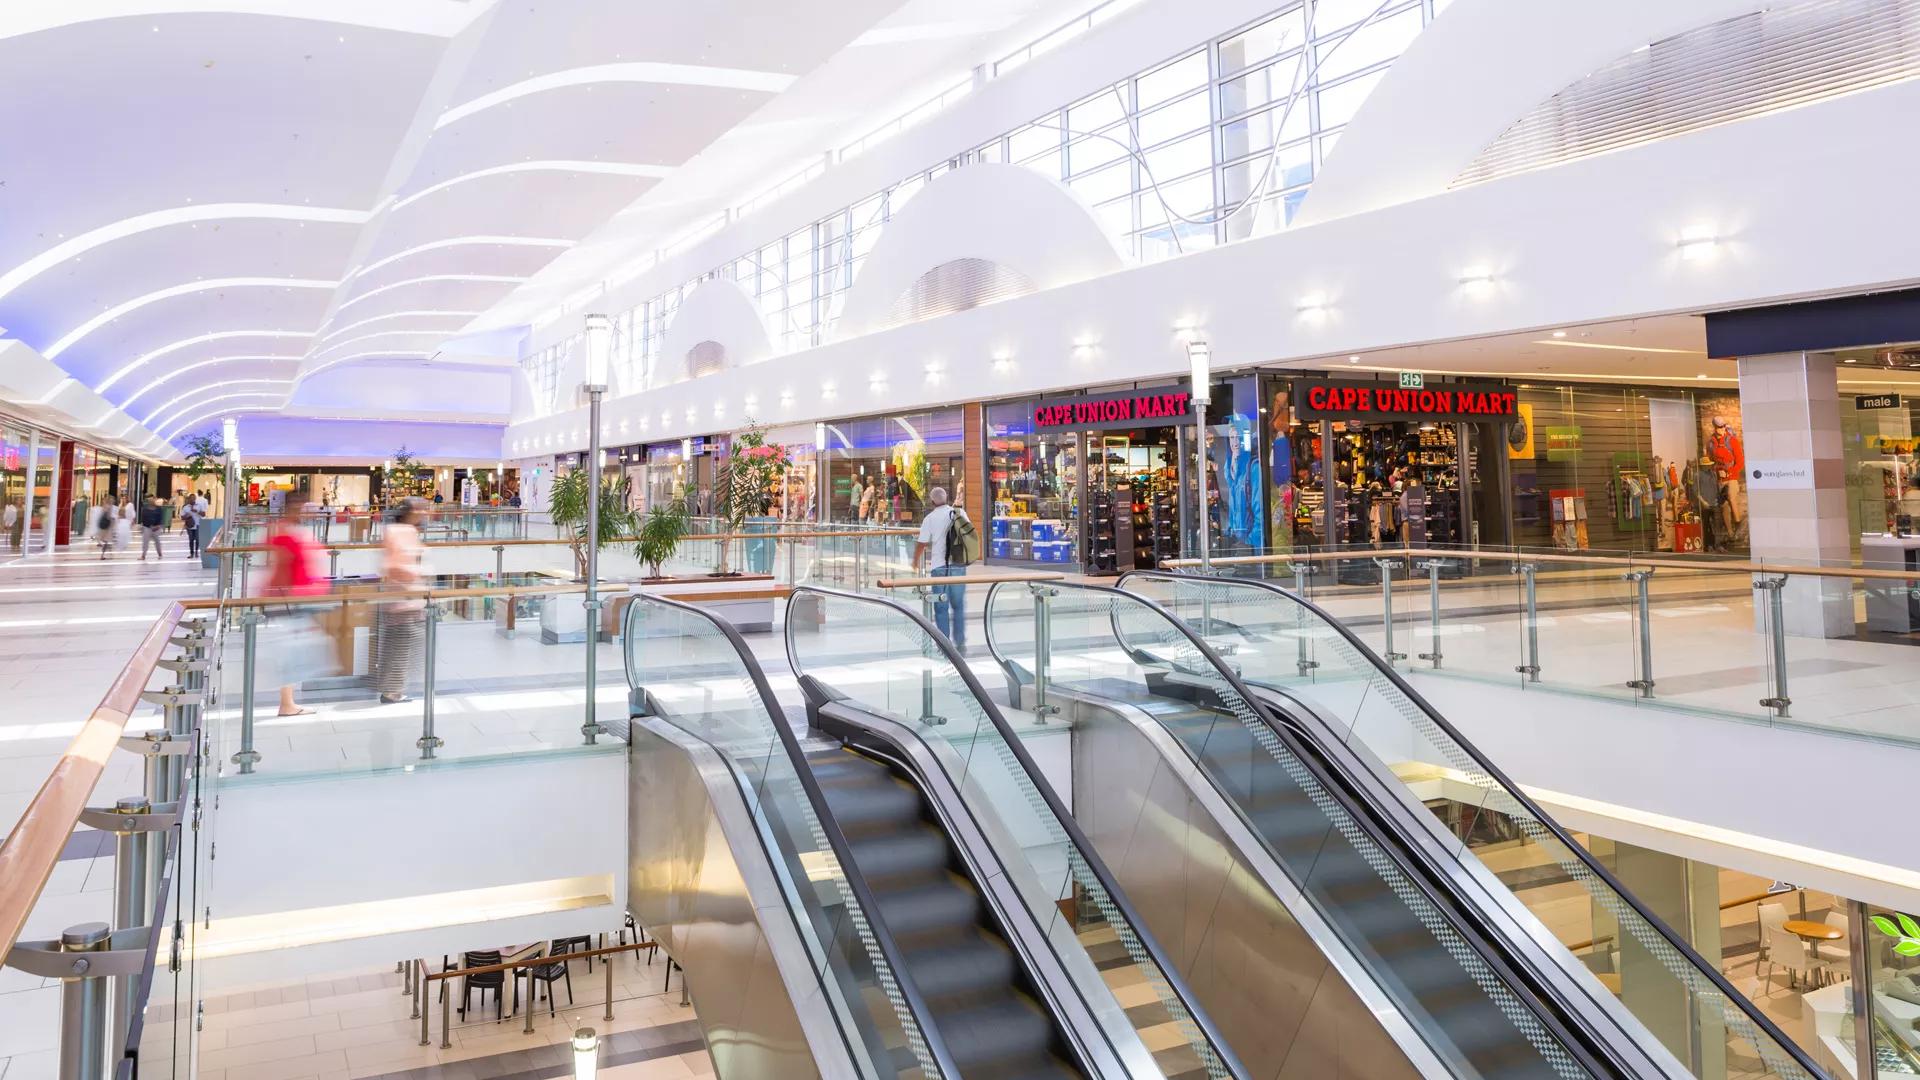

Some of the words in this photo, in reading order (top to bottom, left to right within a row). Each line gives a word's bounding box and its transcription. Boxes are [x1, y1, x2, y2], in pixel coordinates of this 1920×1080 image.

[1034, 404, 1073, 427] CAPE
[1075, 398, 1131, 424] UNION
[1135, 392, 1188, 419] MART
[1309, 386, 1371, 412] CAPE
[1376, 389, 1452, 414] UNION
[1456, 391, 1516, 415] MART
[1863, 396, 1891, 408] male
